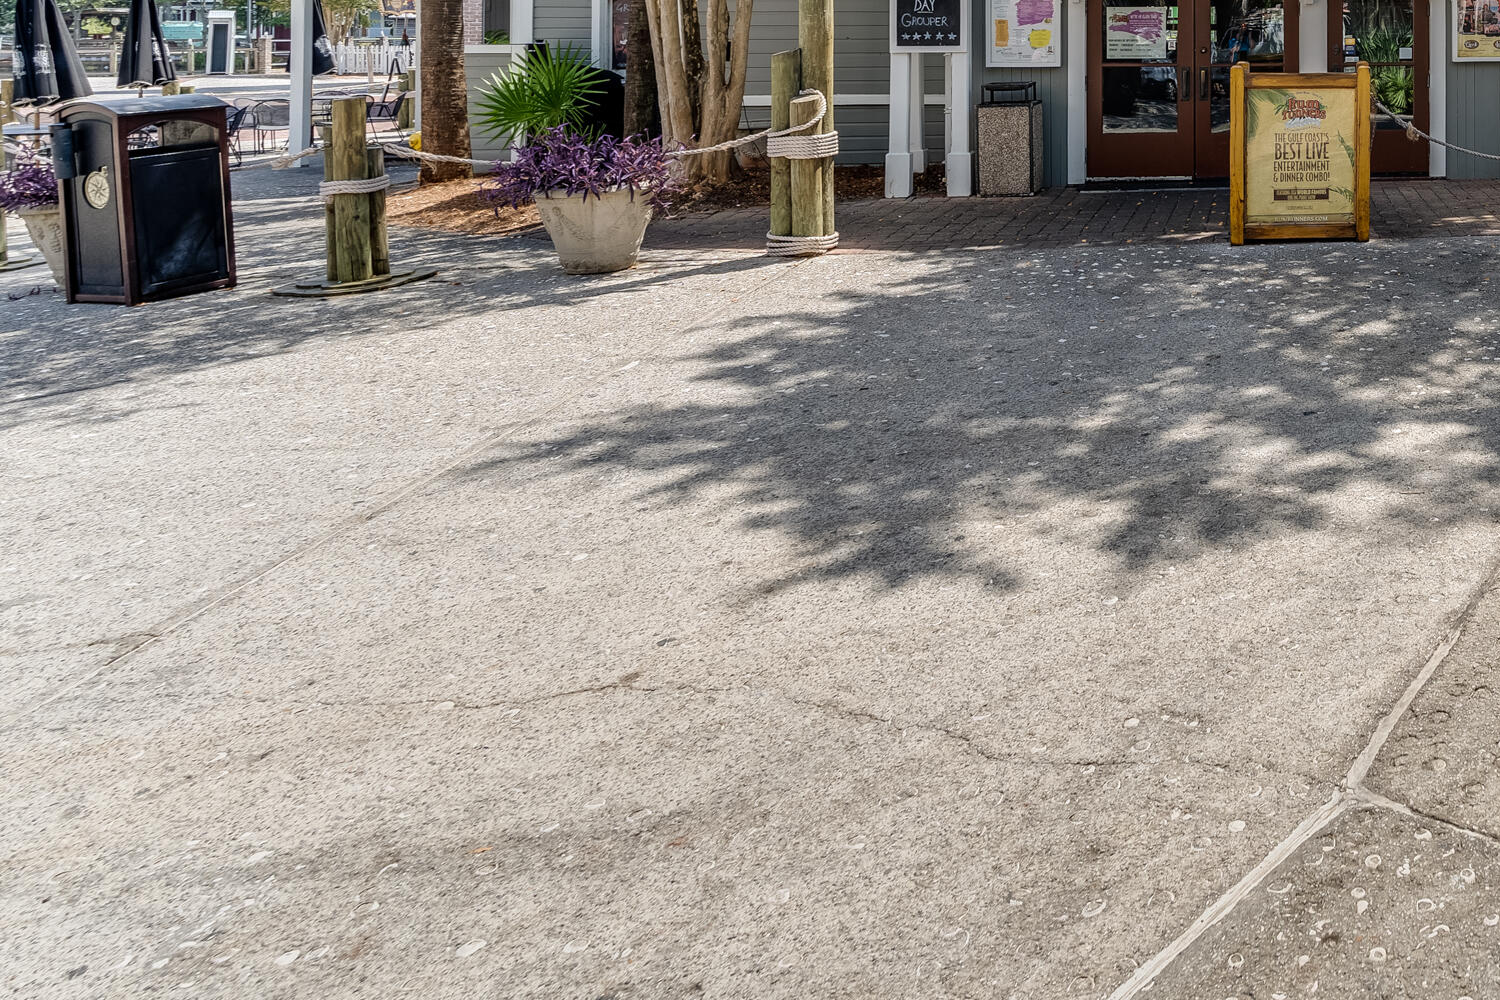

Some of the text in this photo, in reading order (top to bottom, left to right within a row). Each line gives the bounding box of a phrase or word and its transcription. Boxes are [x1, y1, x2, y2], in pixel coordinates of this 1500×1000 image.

[901, 12, 949, 28] GROUPER
[1274, 132, 1330, 143] THE GULF COAST'S
[1274, 142, 1330, 160] BEST LIVE
[1273, 160, 1330, 172] ENTERTAINMENT
[1273, 171, 1330, 183] & DINNER COMBO!
